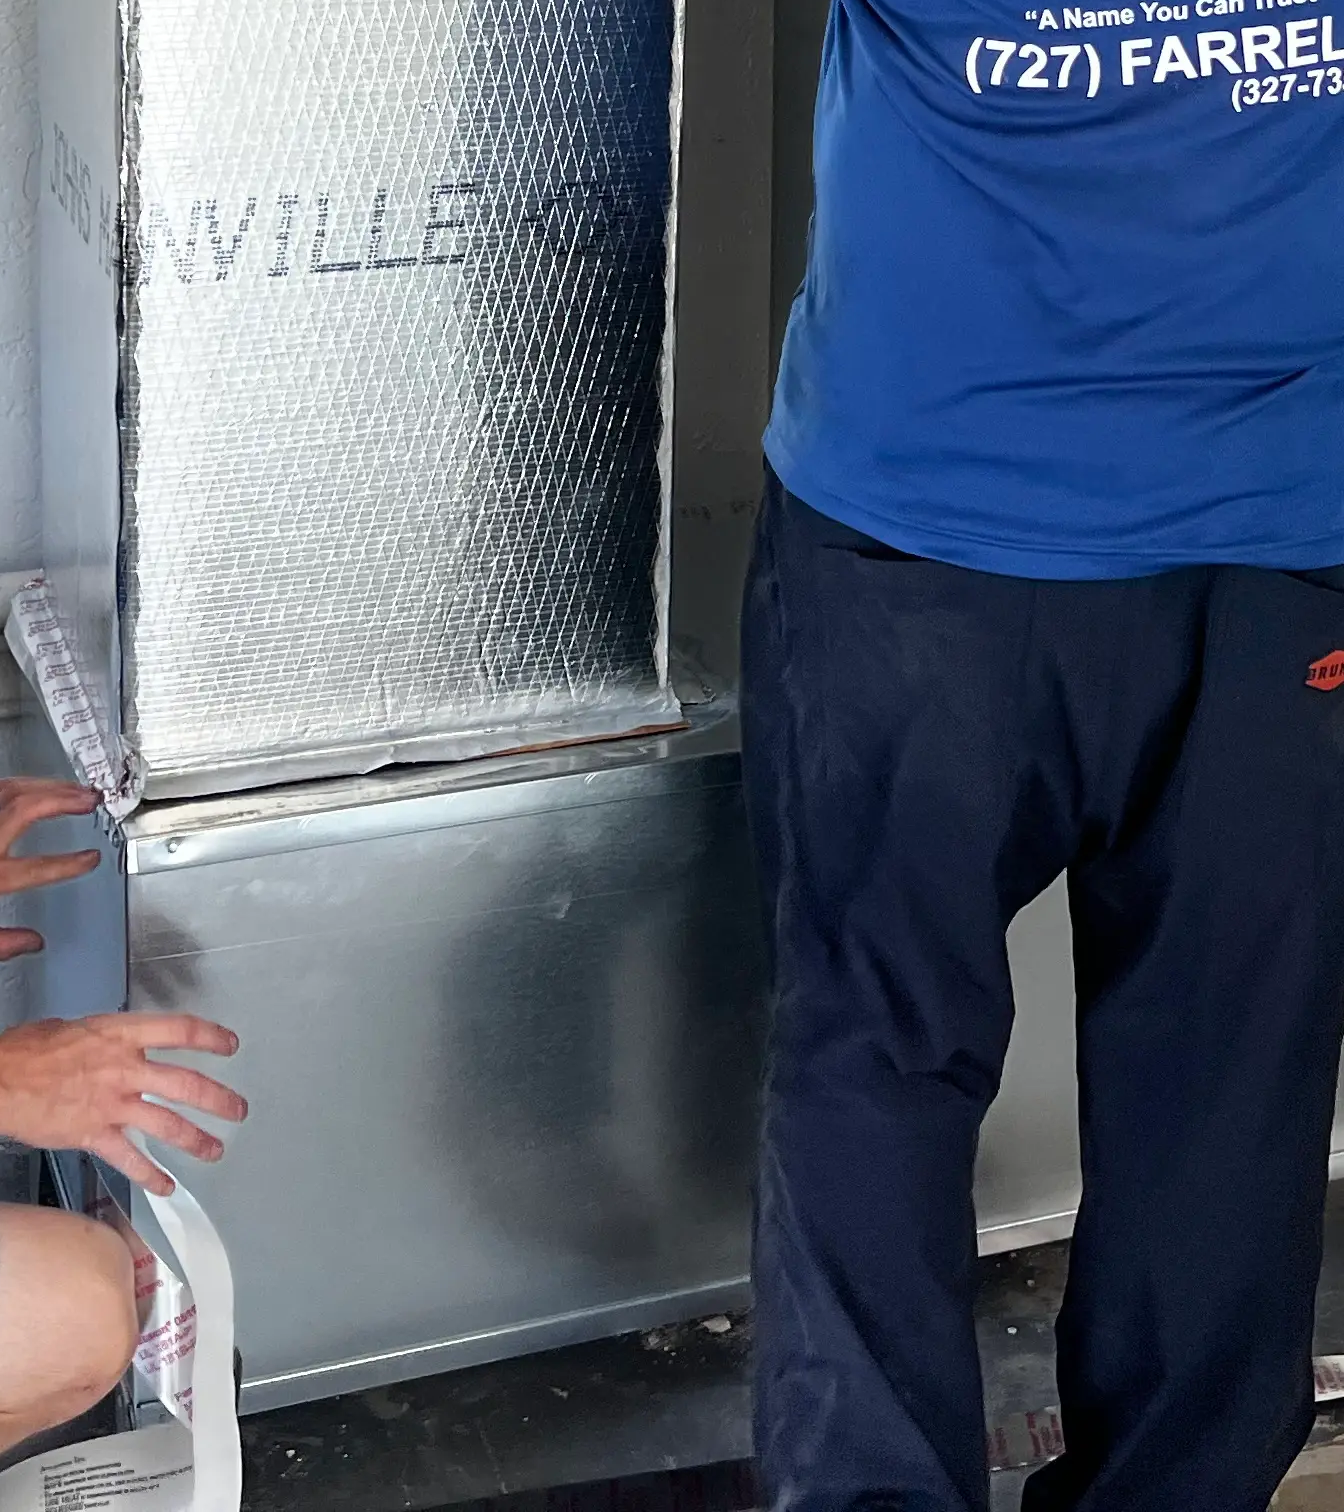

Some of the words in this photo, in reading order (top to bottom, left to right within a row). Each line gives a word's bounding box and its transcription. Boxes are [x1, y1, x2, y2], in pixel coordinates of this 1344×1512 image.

[1063, 5, 1135, 29] Name
[1139, 0, 1189, 24] You
[965, 37, 1102, 99] (727)
